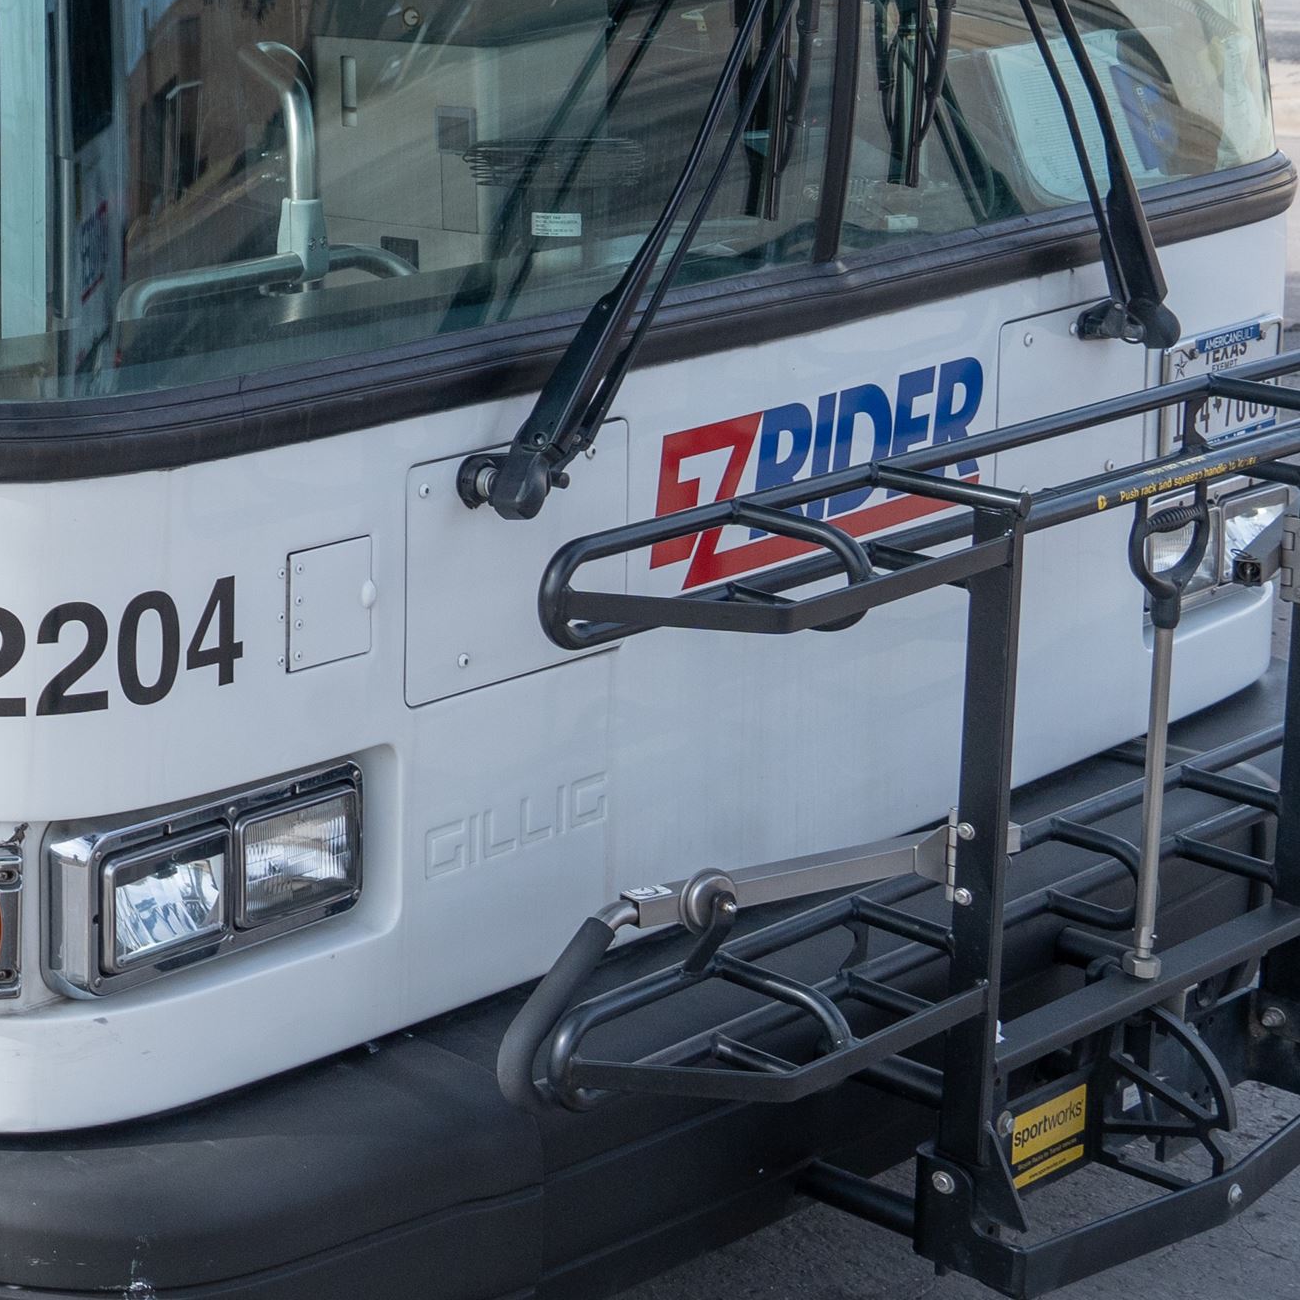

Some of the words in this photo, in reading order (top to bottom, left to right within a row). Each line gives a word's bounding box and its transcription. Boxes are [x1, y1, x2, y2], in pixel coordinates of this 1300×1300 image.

[1120, 487, 1140, 502] Push
[1140, 483, 1157, 497] rack
[1158, 478, 1172, 493] and
[424, 771, 608, 881] GILLIG
[1014, 1100, 1083, 1148] sportworks
